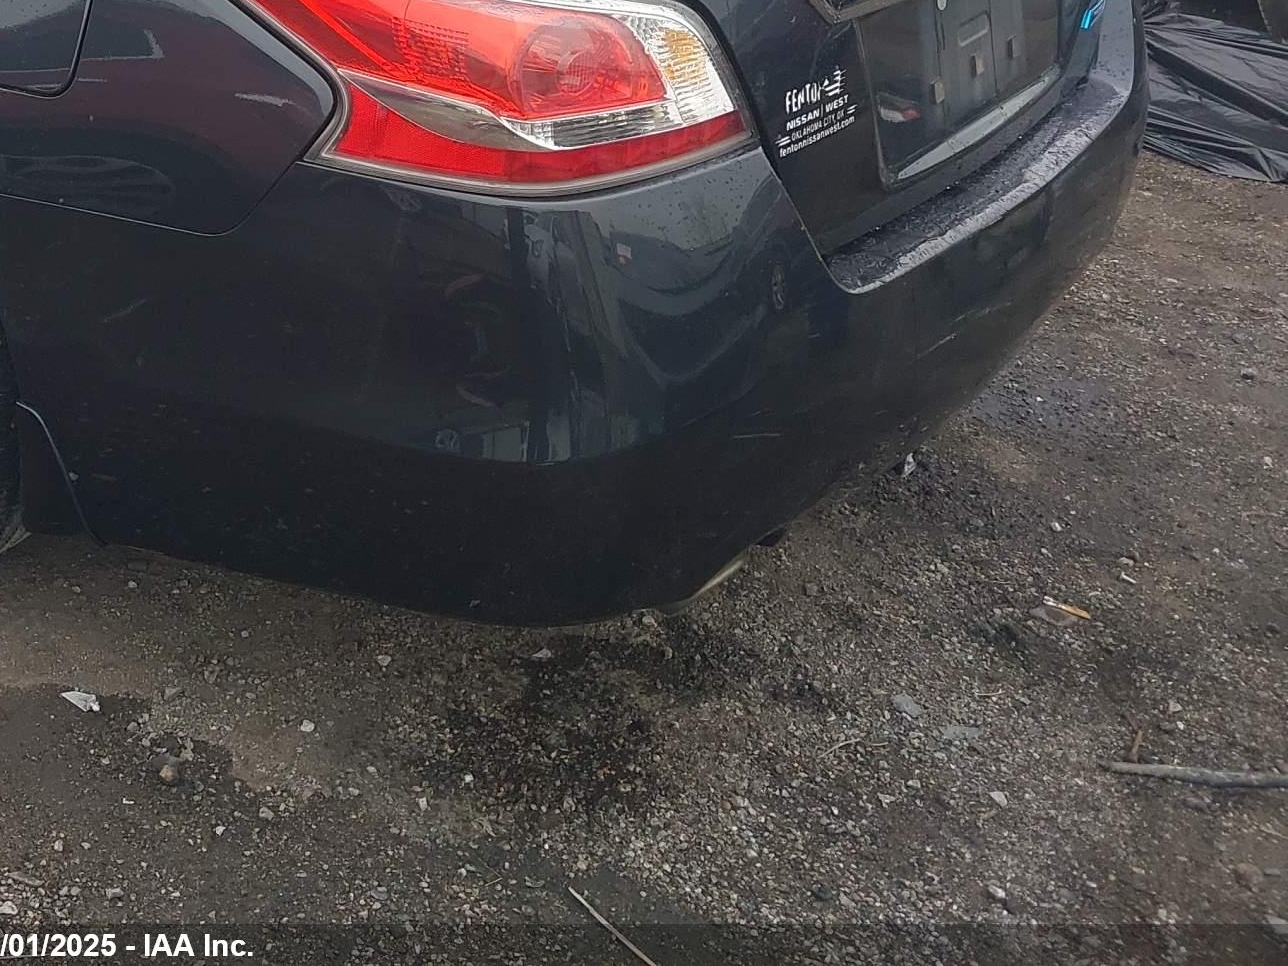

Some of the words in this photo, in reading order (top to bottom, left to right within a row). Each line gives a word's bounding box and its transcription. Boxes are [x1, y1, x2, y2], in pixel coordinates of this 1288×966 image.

[786, 108, 820, 131] NISSAN
[825, 94, 848, 113] WEST
[791, 120, 822, 141] OKLAHOMA
[779, 116, 855, 158] fentonnissanwest.com
